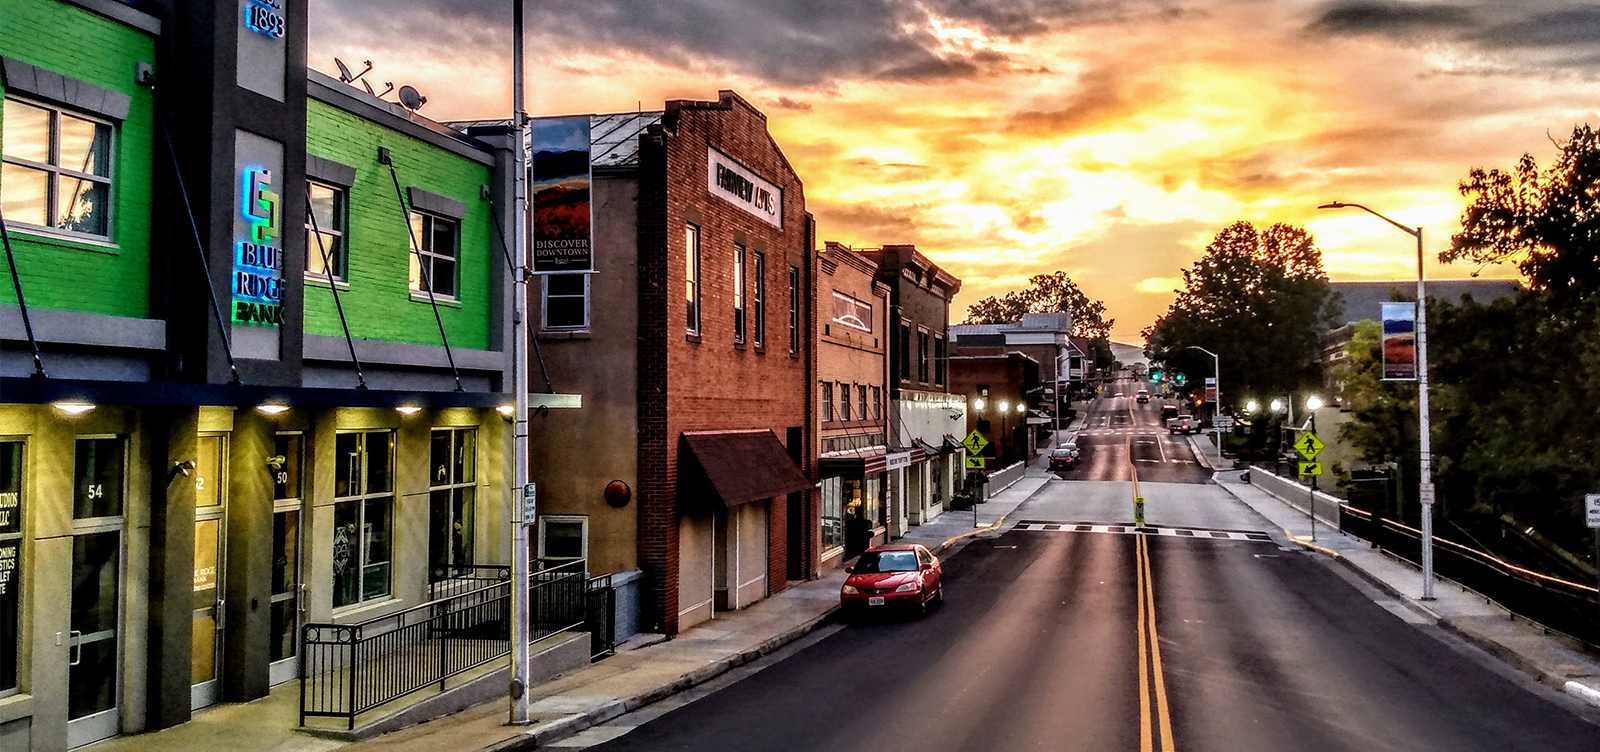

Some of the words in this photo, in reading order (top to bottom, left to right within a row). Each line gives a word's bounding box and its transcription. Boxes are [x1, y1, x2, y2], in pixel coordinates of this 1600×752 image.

[251, 5, 285, 37] 1893
[536, 239, 589, 249] DISCOVER
[536, 248, 589, 257] DOWNTOWN
[242, 243, 283, 269] BLUE
[236, 271, 287, 300] RIDGE
[236, 301, 286, 325] BANK
[277, 472, 288, 484] 50
[88, 484, 103, 499] 54
